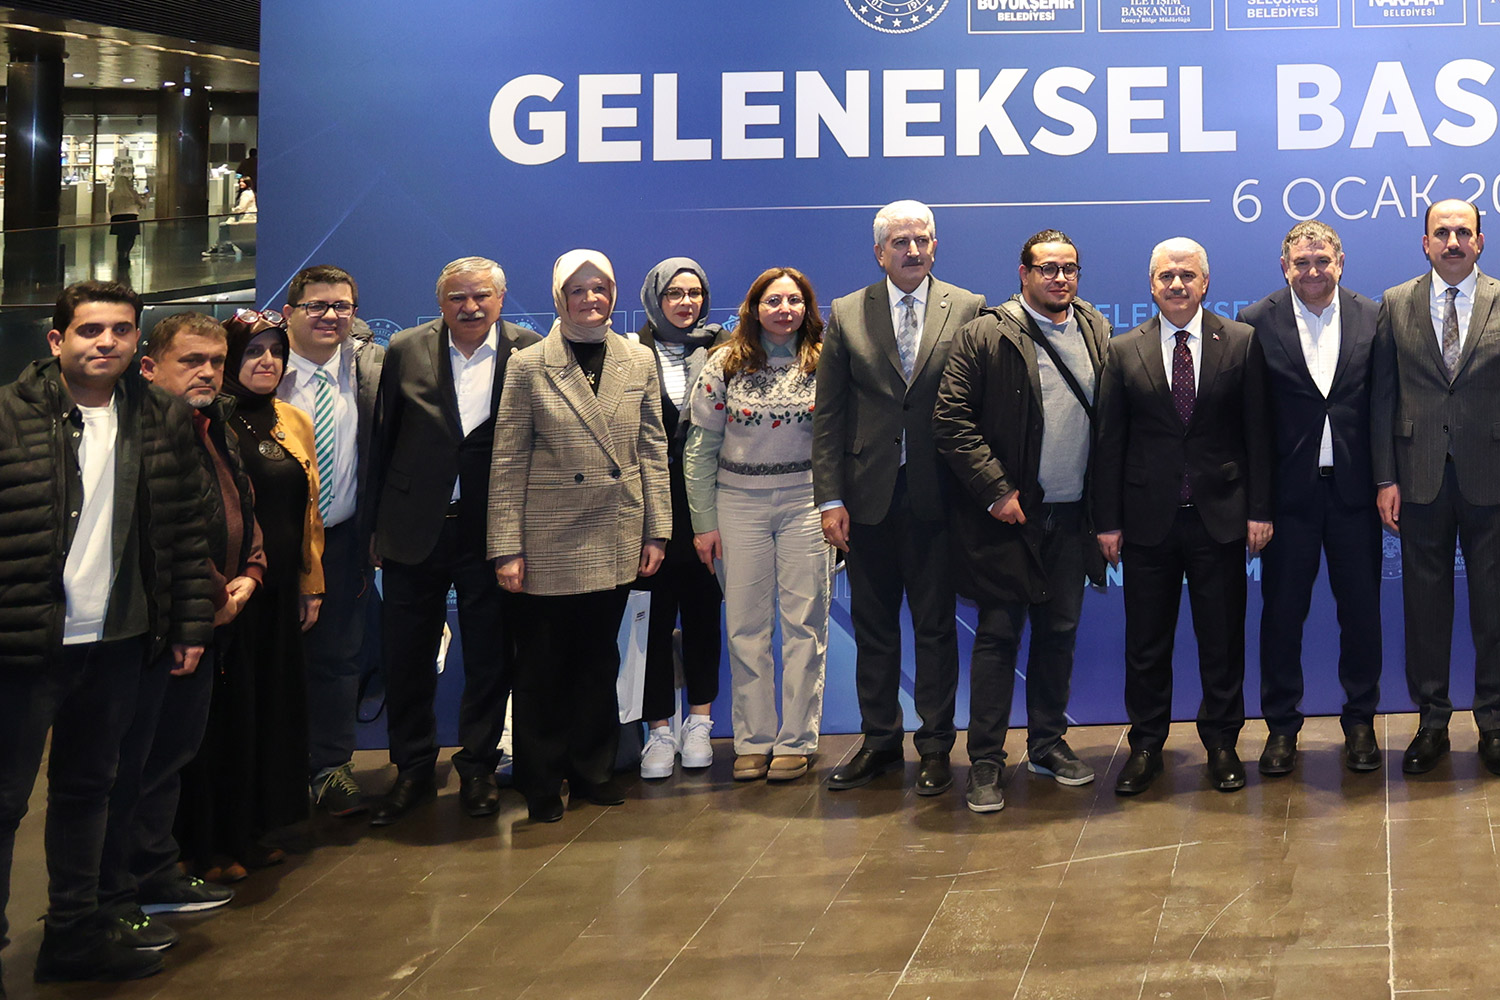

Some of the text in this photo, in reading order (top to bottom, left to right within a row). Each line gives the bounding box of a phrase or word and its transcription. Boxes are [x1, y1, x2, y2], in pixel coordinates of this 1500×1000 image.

[997, 9, 1055, 22] BELEDİYESİ
[1121, 4, 1191, 18] BAŞKANLIĞI
[1247, 5, 1319, 19] BELEDİYESİ
[1383, 6, 1436, 17] BELEDİYESİ
[489, 65, 1237, 166] GELENEKSEL
[1231, 178, 1263, 224] 6
[1281, 173, 1439, 222] OCAK
